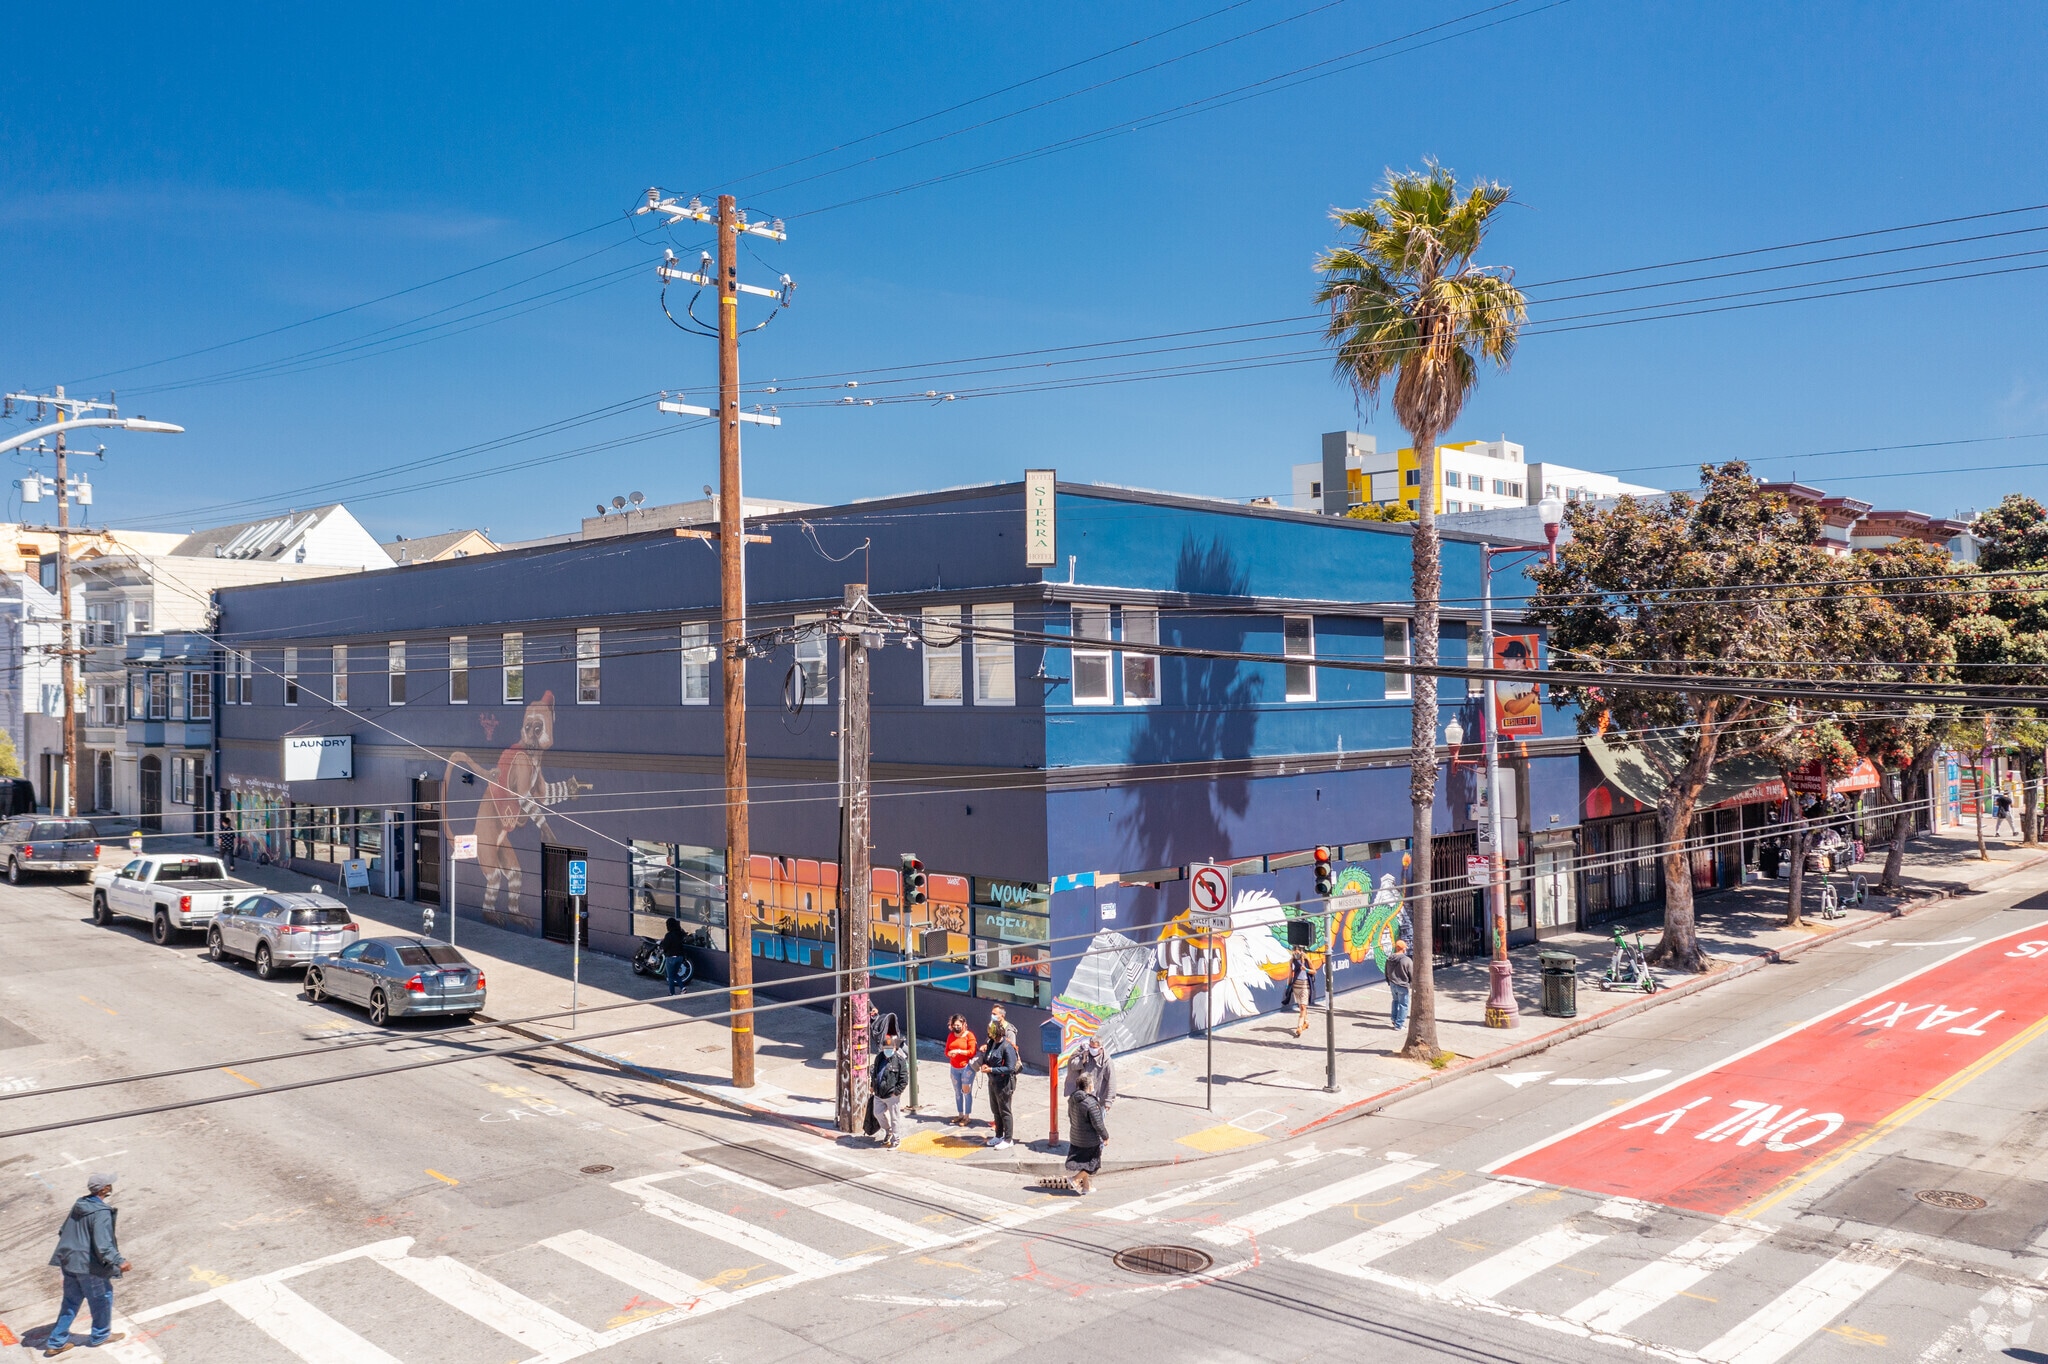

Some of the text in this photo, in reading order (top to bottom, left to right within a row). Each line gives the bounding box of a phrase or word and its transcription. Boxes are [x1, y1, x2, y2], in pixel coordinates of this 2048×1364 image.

[1034, 486, 1048, 548] SIERRA
[1028, 553, 1053, 561] HOTEL
[293, 739, 347, 748] LAUNDRY
[1800, 782, 1821, 790] NIÑOS
[991, 884, 1027, 904] NOW
[1212, 918, 1226, 927] MUNI
[1848, 1001, 2005, 1037] TAXI
[1619, 1096, 1845, 1152] ONLY
